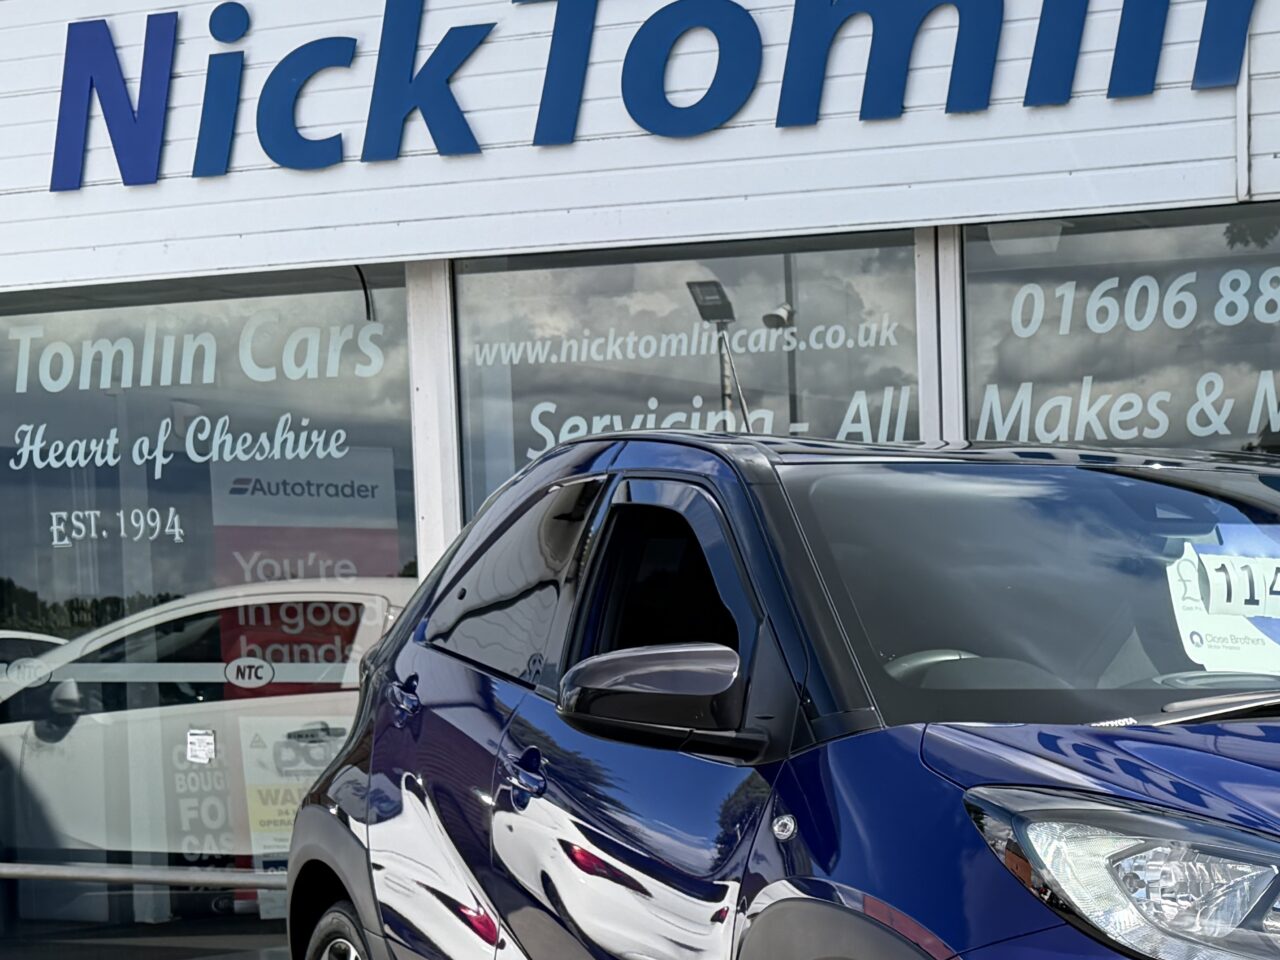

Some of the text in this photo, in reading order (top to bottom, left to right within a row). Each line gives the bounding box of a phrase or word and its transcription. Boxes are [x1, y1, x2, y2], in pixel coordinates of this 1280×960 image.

[50, 0, 497, 192] Nick
[1010, 272, 1197, 338] 01606
[8, 309, 385, 393] Tomlin Cars
[474, 318, 899, 367] www.nicktomlincars.co.uk
[836, 386, 910, 443] All
[976, 376, 1171, 443] Makes
[1186, 371, 1235, 436] &
[9, 412, 349, 480] Heart of Cheshire
[250, 478, 378, 499] Autotrader
[50, 507, 183, 547] EST. 1994
[237, 593, 384, 634] in good
[235, 665, 264, 681] NTC
[174, 769, 231, 794] BOUG
[178, 796, 233, 832] FO
[182, 831, 236, 862] CAS
